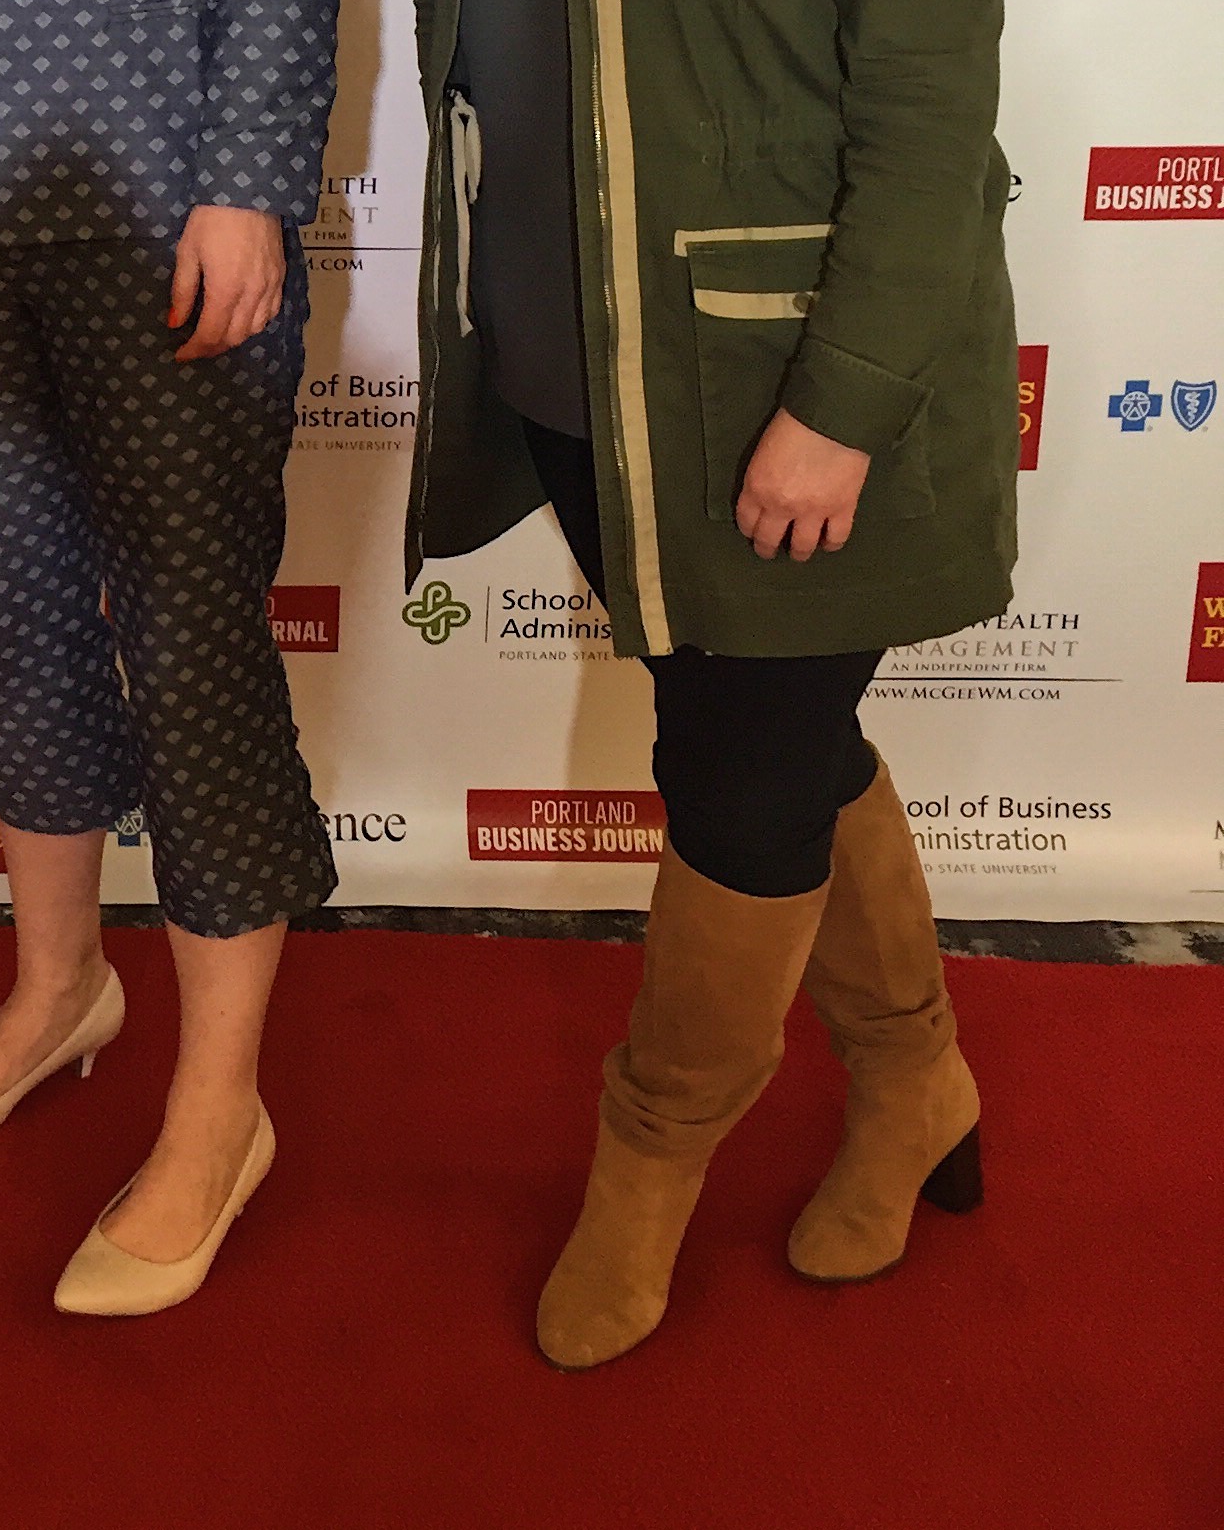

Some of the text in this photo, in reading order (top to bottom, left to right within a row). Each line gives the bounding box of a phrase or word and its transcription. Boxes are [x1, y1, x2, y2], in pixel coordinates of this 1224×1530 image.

[1158, 157, 1224, 181] PORTL
[1096, 185, 1212, 210] BUSINESS
[310, 374, 420, 397] of Busin
[294, 406, 415, 427] istration
[325, 440, 401, 451] UNIVERSITY
[502, 589, 592, 610] School
[272, 621, 328, 642] RNAL
[499, 617, 612, 639] Adminis
[499, 651, 610, 661] PORTLAND STATE
[891, 663, 1046, 672] AN INDEPENDENT FIRM
[532, 800, 635, 824] PORTLAND
[960, 795, 1111, 819] of Business
[478, 827, 664, 852] BUSINESS JOURN
[938, 864, 1056, 874] STATE UNIVERSITY
